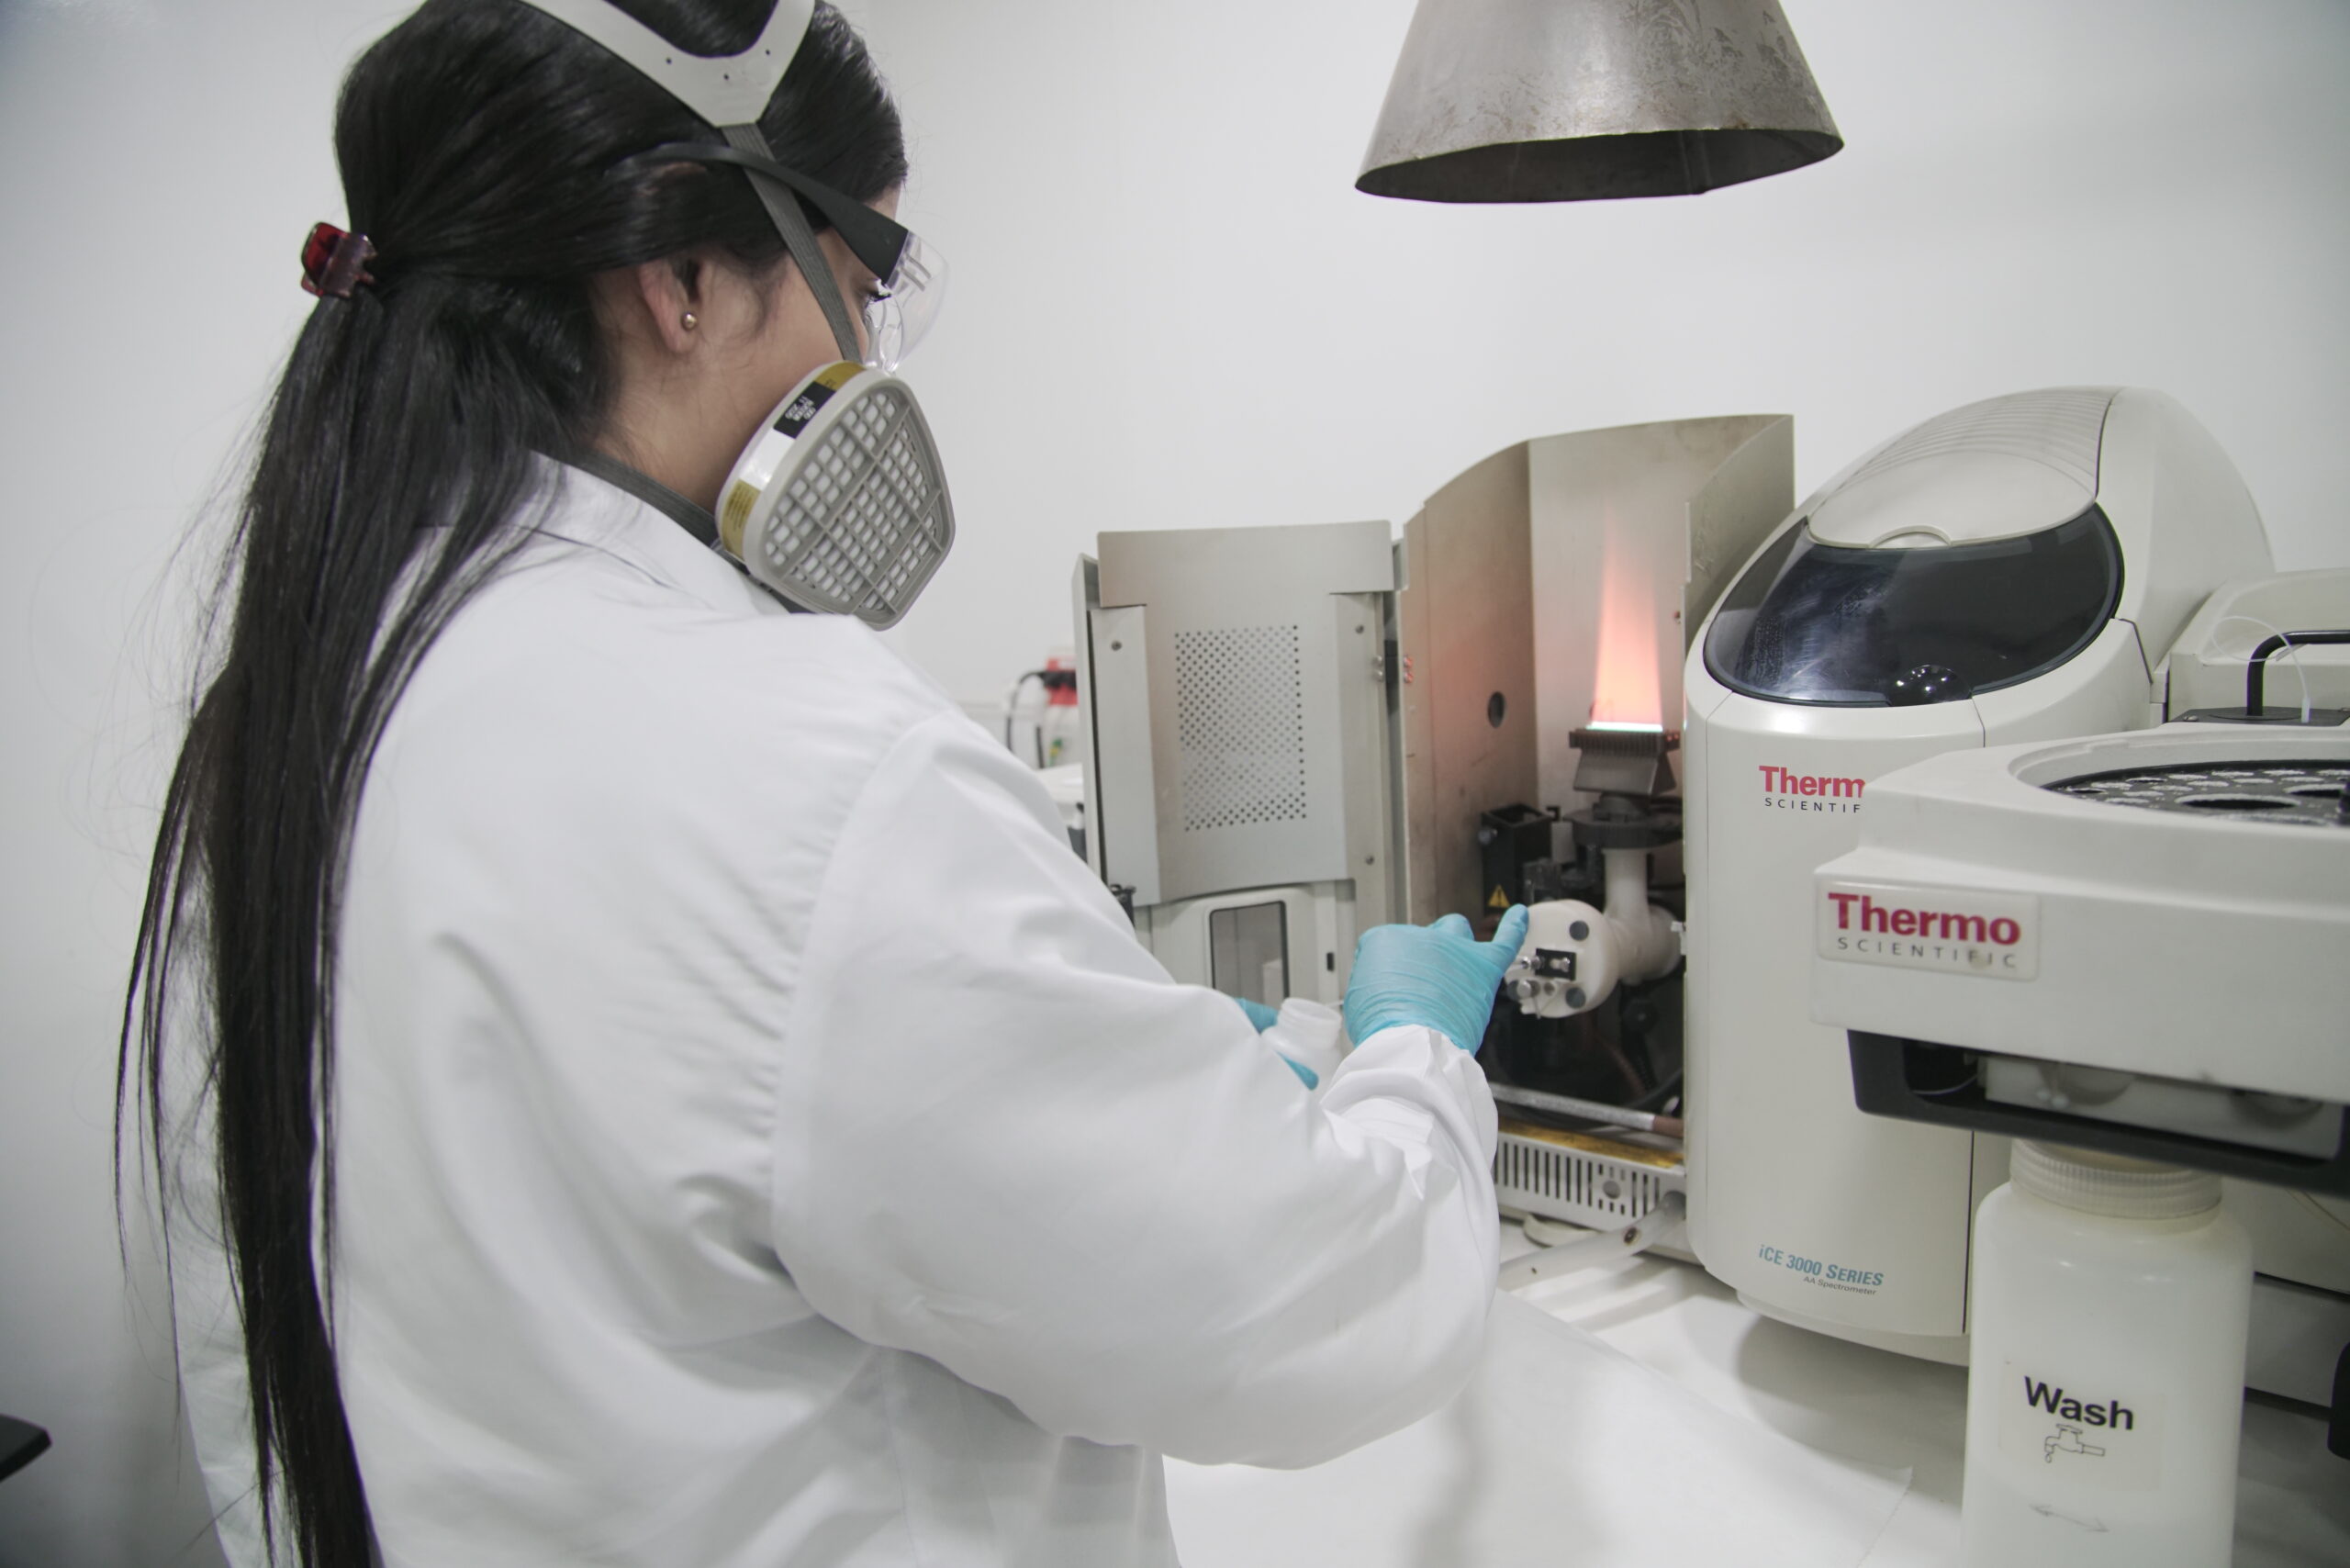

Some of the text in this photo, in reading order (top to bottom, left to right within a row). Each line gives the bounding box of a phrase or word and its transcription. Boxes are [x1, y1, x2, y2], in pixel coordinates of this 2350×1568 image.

[1759, 765, 1866, 799] Therm
[1764, 797, 1862, 813] SCIENTIF
[1828, 891, 2022, 946] Thermo
[1838, 936, 2017, 969] SCIENTIFIC
[1758, 1244, 1885, 1286] iCE 3000 SERIES
[1803, 1275, 1877, 1296] AA Spectrometer
[2024, 1375, 2134, 1430] Wash
